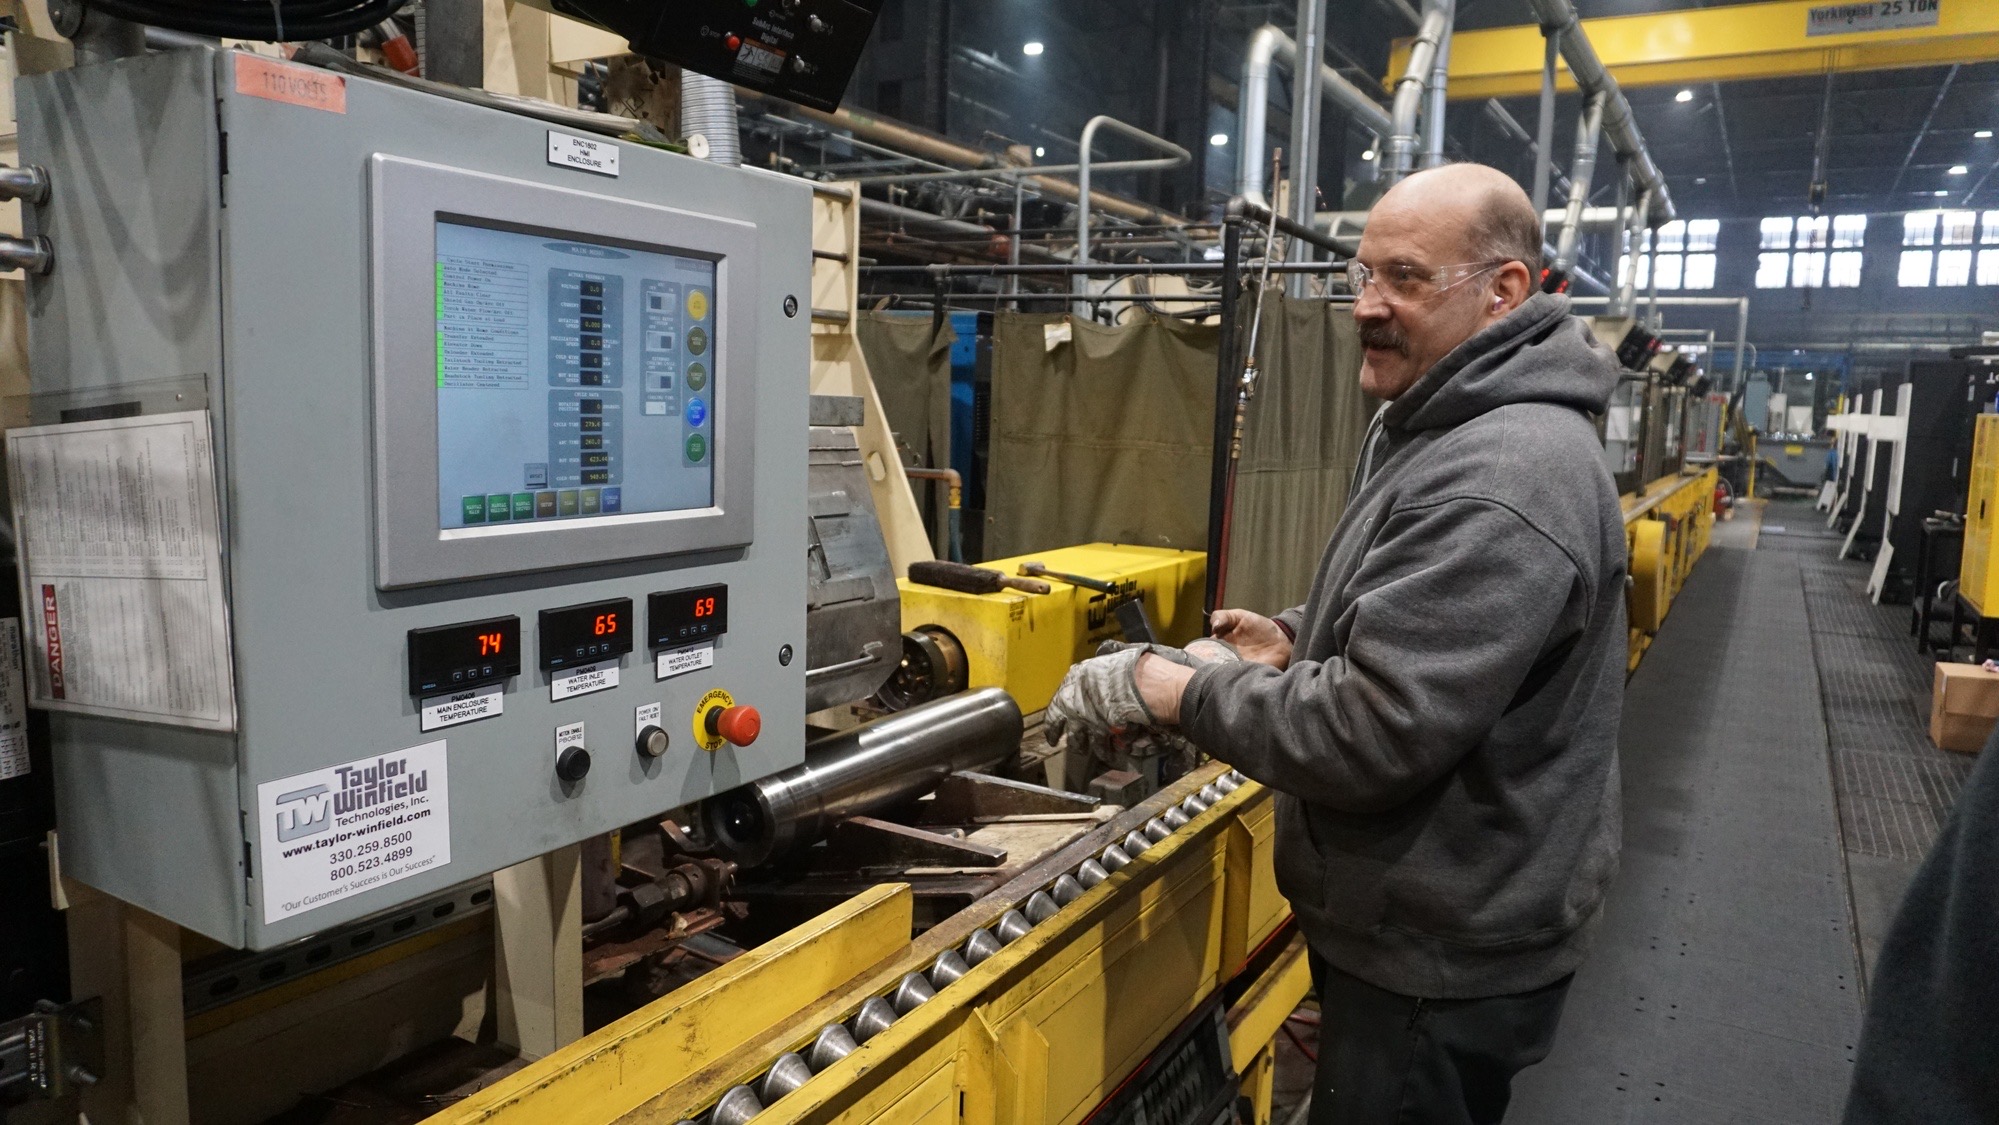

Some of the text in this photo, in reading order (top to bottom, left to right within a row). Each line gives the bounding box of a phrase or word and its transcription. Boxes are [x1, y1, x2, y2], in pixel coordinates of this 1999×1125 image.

[1880, 1, 1902, 16] 25
[1909, 0, 1937, 13] TON
[263, 72, 327, 101] 110 VOLTS
[568, 155, 602, 168] ENCLOSURE
[580, 149, 590, 157] HMI
[695, 598, 715, 617] 69
[596, 614, 616, 635] 65
[46, 596, 62, 687] DANGER
[479, 633, 501, 656] 74
[668, 652, 703, 664] WATER OUTLET
[670, 659, 702, 672] TEMPERATURE
[566, 679, 606, 693] TEMPERATURE
[568, 674, 588, 684] WATER
[436, 698, 489, 714] MAIN ENCLOSURE
[697, 690, 733, 714] EMERGENCY
[440, 706, 488, 722] TEMPERATURE
[571, 727, 583, 735] ENABLE
[705, 738, 723, 750] STOP
[334, 758, 407, 790] Taylor
[333, 770, 428, 816] Winfield
[336, 795, 429, 828] Technologies, Inc.
[282, 808, 431, 859] www.taylor-winfield.com
[329, 830, 413, 865] 330.259.8500
[330, 846, 413, 882] 800.523.4899
[350, 875, 381, 891] Success
[382, 872, 388, 880] is
[389, 867, 404, 878] Our
